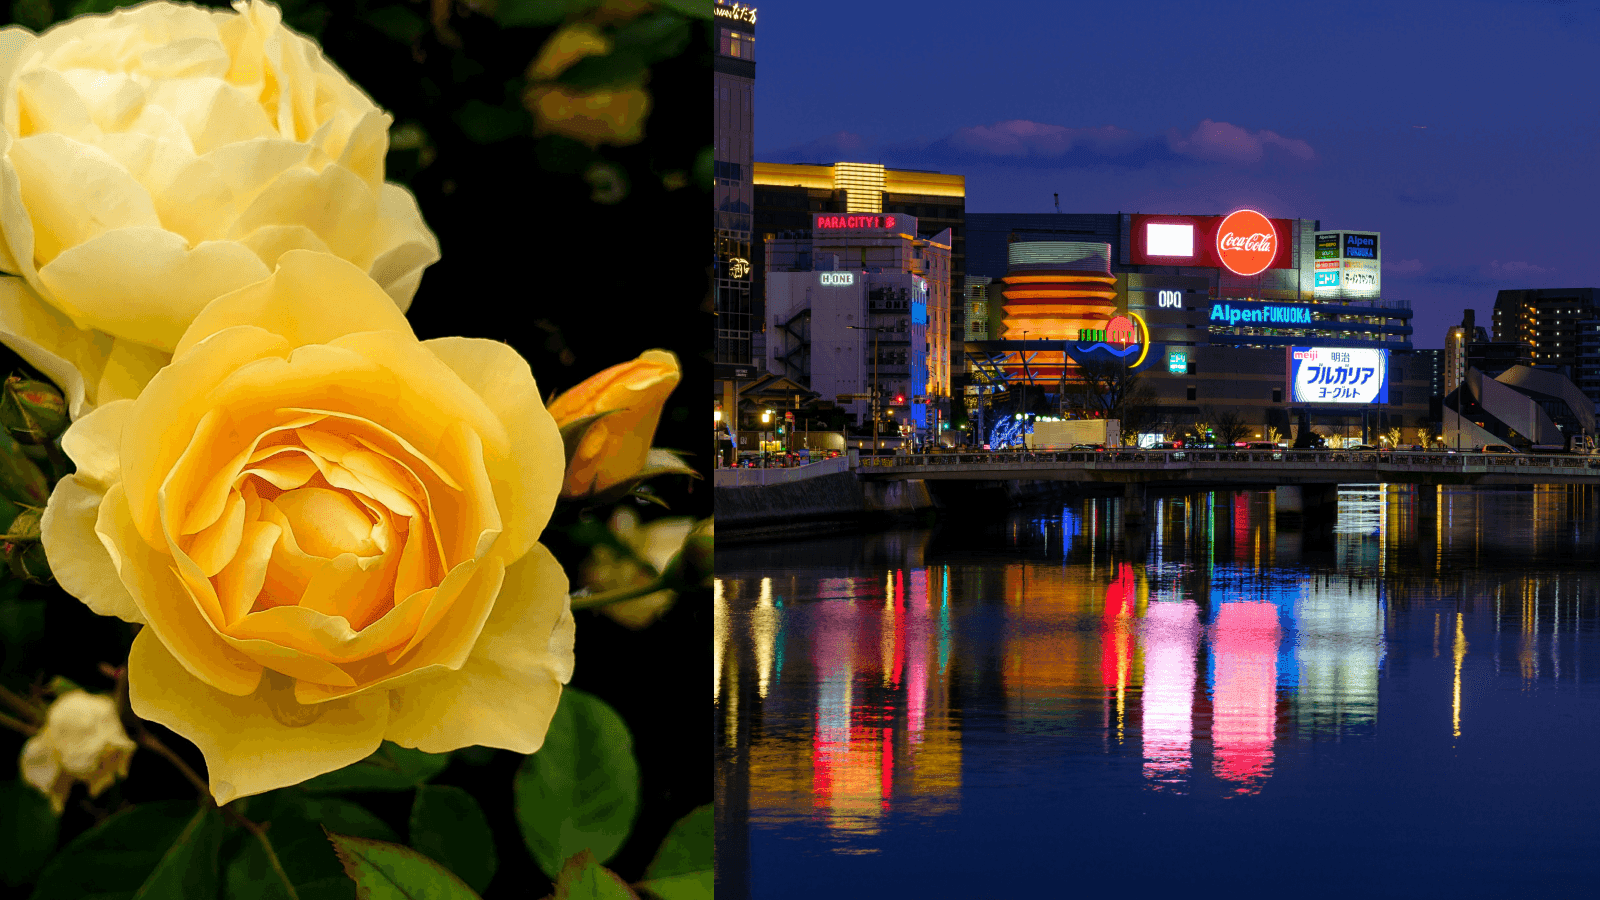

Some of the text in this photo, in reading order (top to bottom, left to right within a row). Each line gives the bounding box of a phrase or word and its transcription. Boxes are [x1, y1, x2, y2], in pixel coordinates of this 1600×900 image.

[1220, 232, 1273, 252] Coca-Cola
[1347, 235, 1374, 247] Alpen
[1318, 273, 1336, 285] ニトリ
[1210, 304, 1312, 325] Alpen FUKUOKA
[1294, 350, 1318, 361] meiji
[1330, 352, 1350, 363] 明治
[1307, 362, 1375, 385] ブルガリア
[1318, 385, 1361, 399] ヨーグルト
